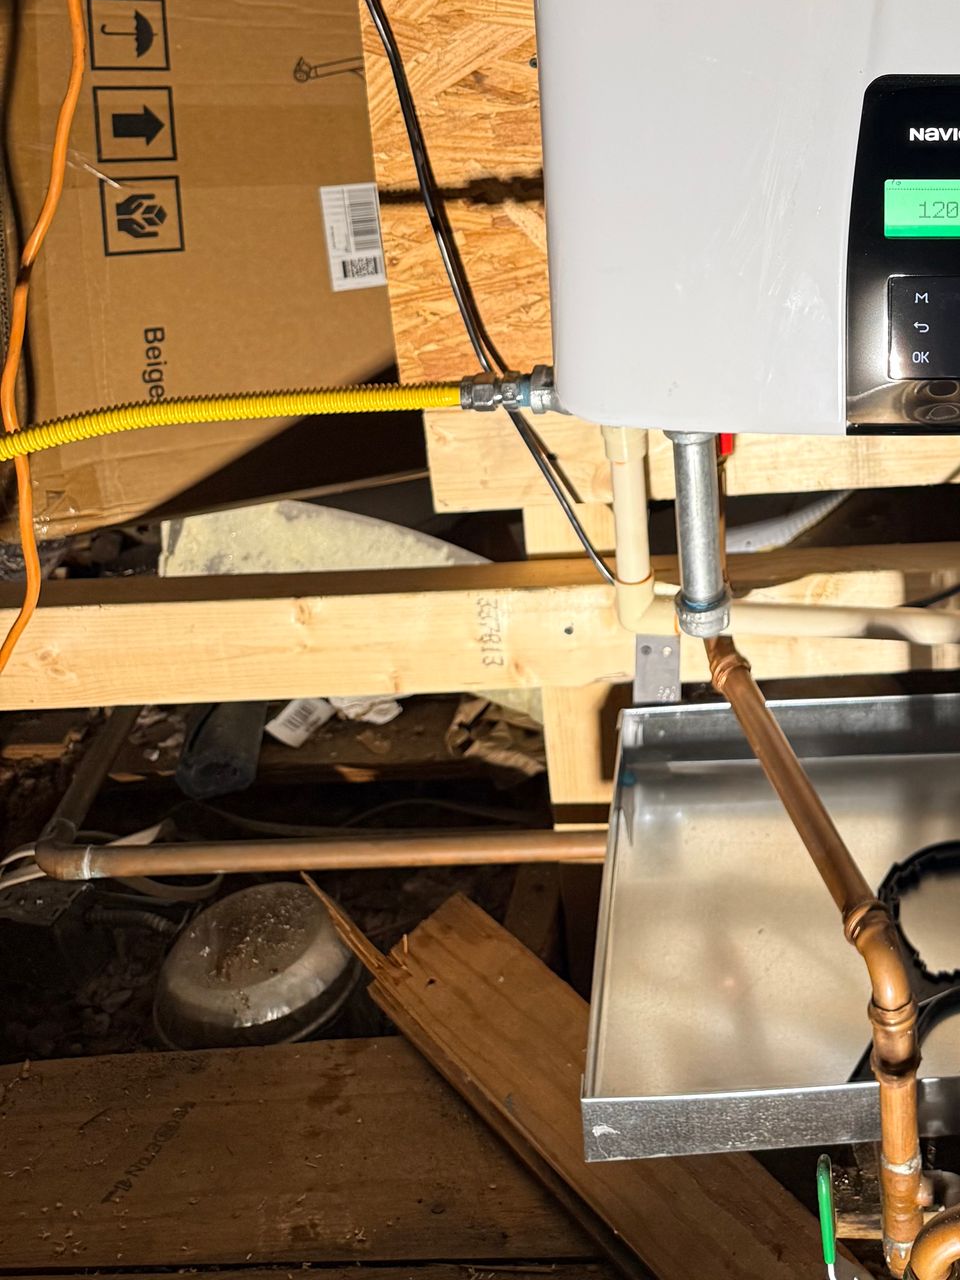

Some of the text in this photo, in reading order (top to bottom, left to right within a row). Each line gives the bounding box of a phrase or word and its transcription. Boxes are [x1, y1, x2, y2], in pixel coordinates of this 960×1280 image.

[914, 292, 929, 304] M
[142, 326, 168, 401] Beige
[912, 351, 930, 364] OK
